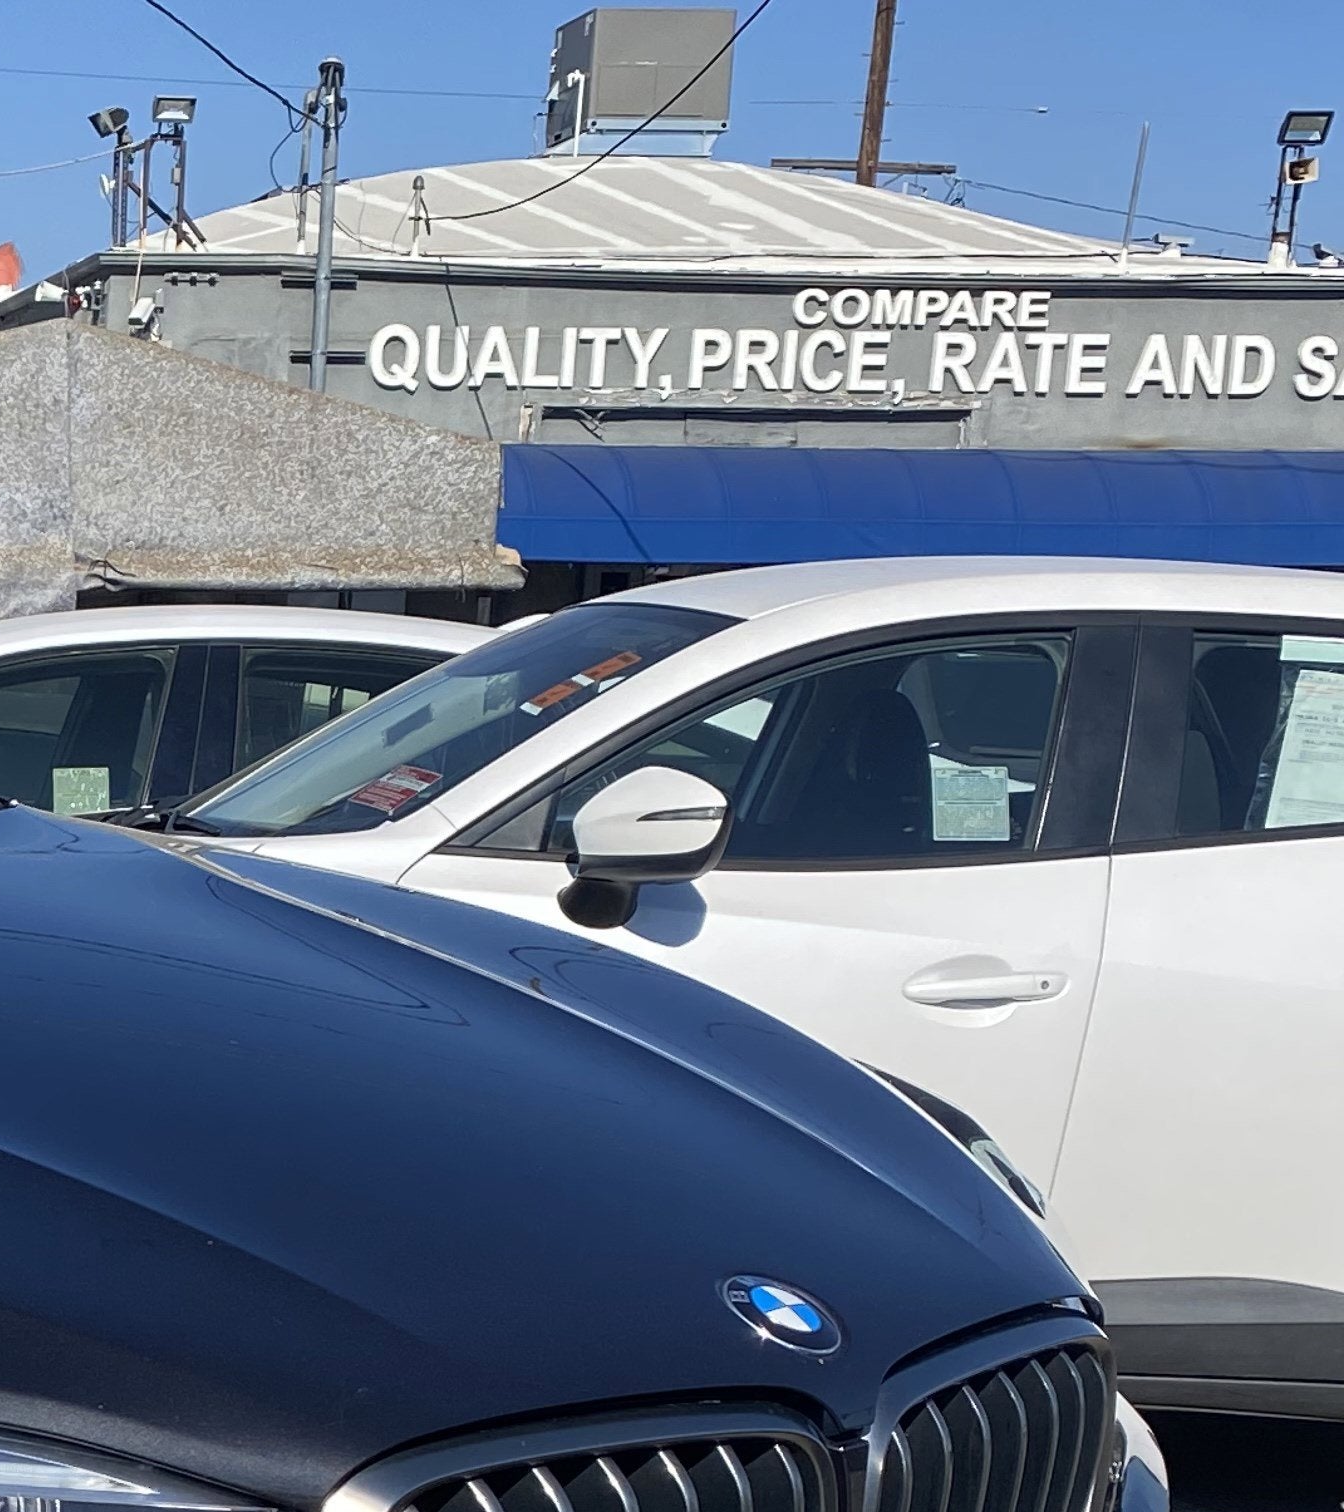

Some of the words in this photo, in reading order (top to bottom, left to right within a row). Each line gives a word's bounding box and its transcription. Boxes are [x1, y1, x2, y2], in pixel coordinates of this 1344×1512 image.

[793, 288, 1051, 329] COMPARE
[368, 323, 672, 400] QUALITY,
[689, 327, 906, 404] PRICE,
[929, 331, 1111, 395] RATE
[1125, 333, 1276, 398] AND
